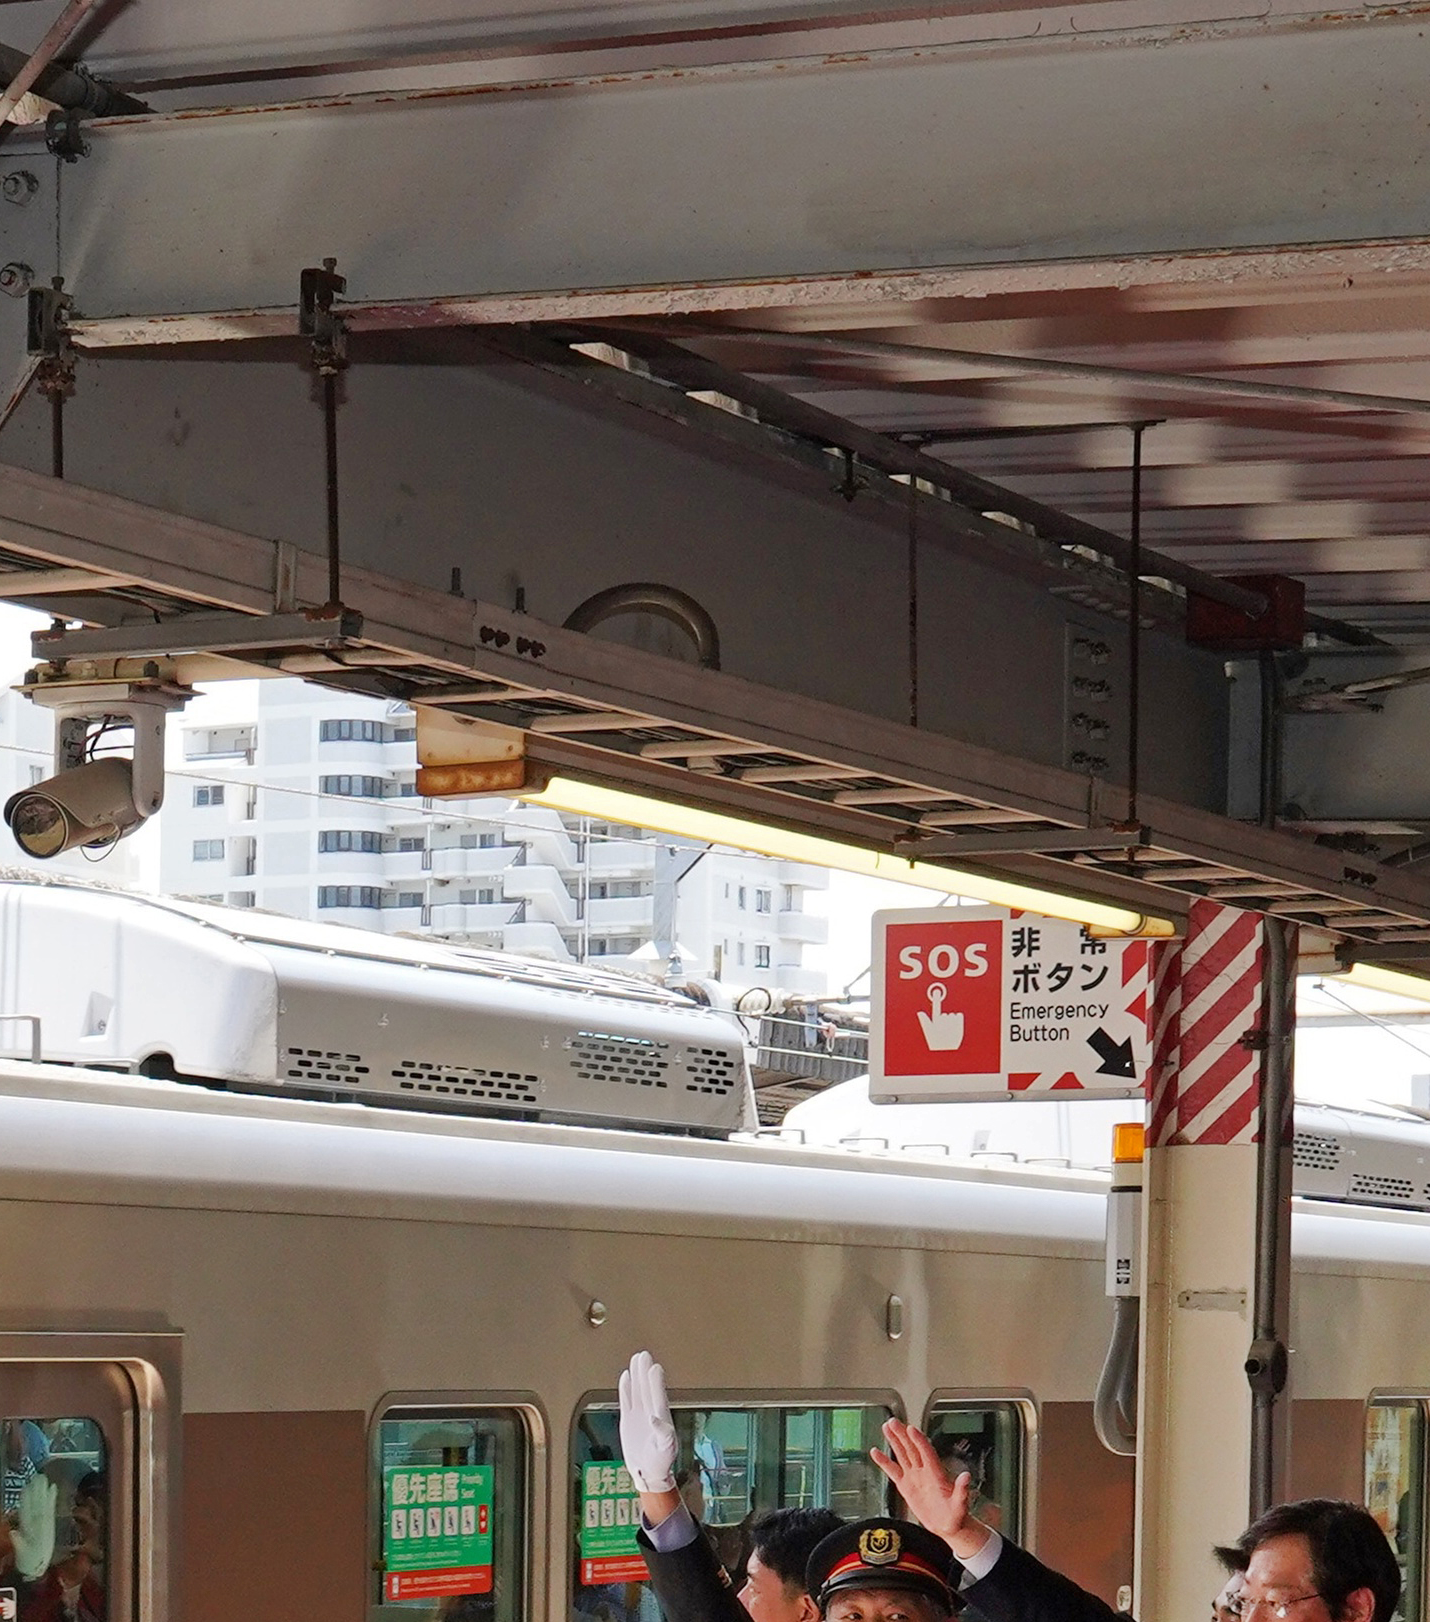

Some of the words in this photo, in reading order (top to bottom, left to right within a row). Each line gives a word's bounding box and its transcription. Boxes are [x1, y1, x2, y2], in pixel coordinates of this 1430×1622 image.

[899, 943, 988, 980] SOS
[1011, 963, 1108, 993] ボタン
[1010, 1002, 1109, 1020] Emergency
[1010, 1024, 1070, 1042] Button
